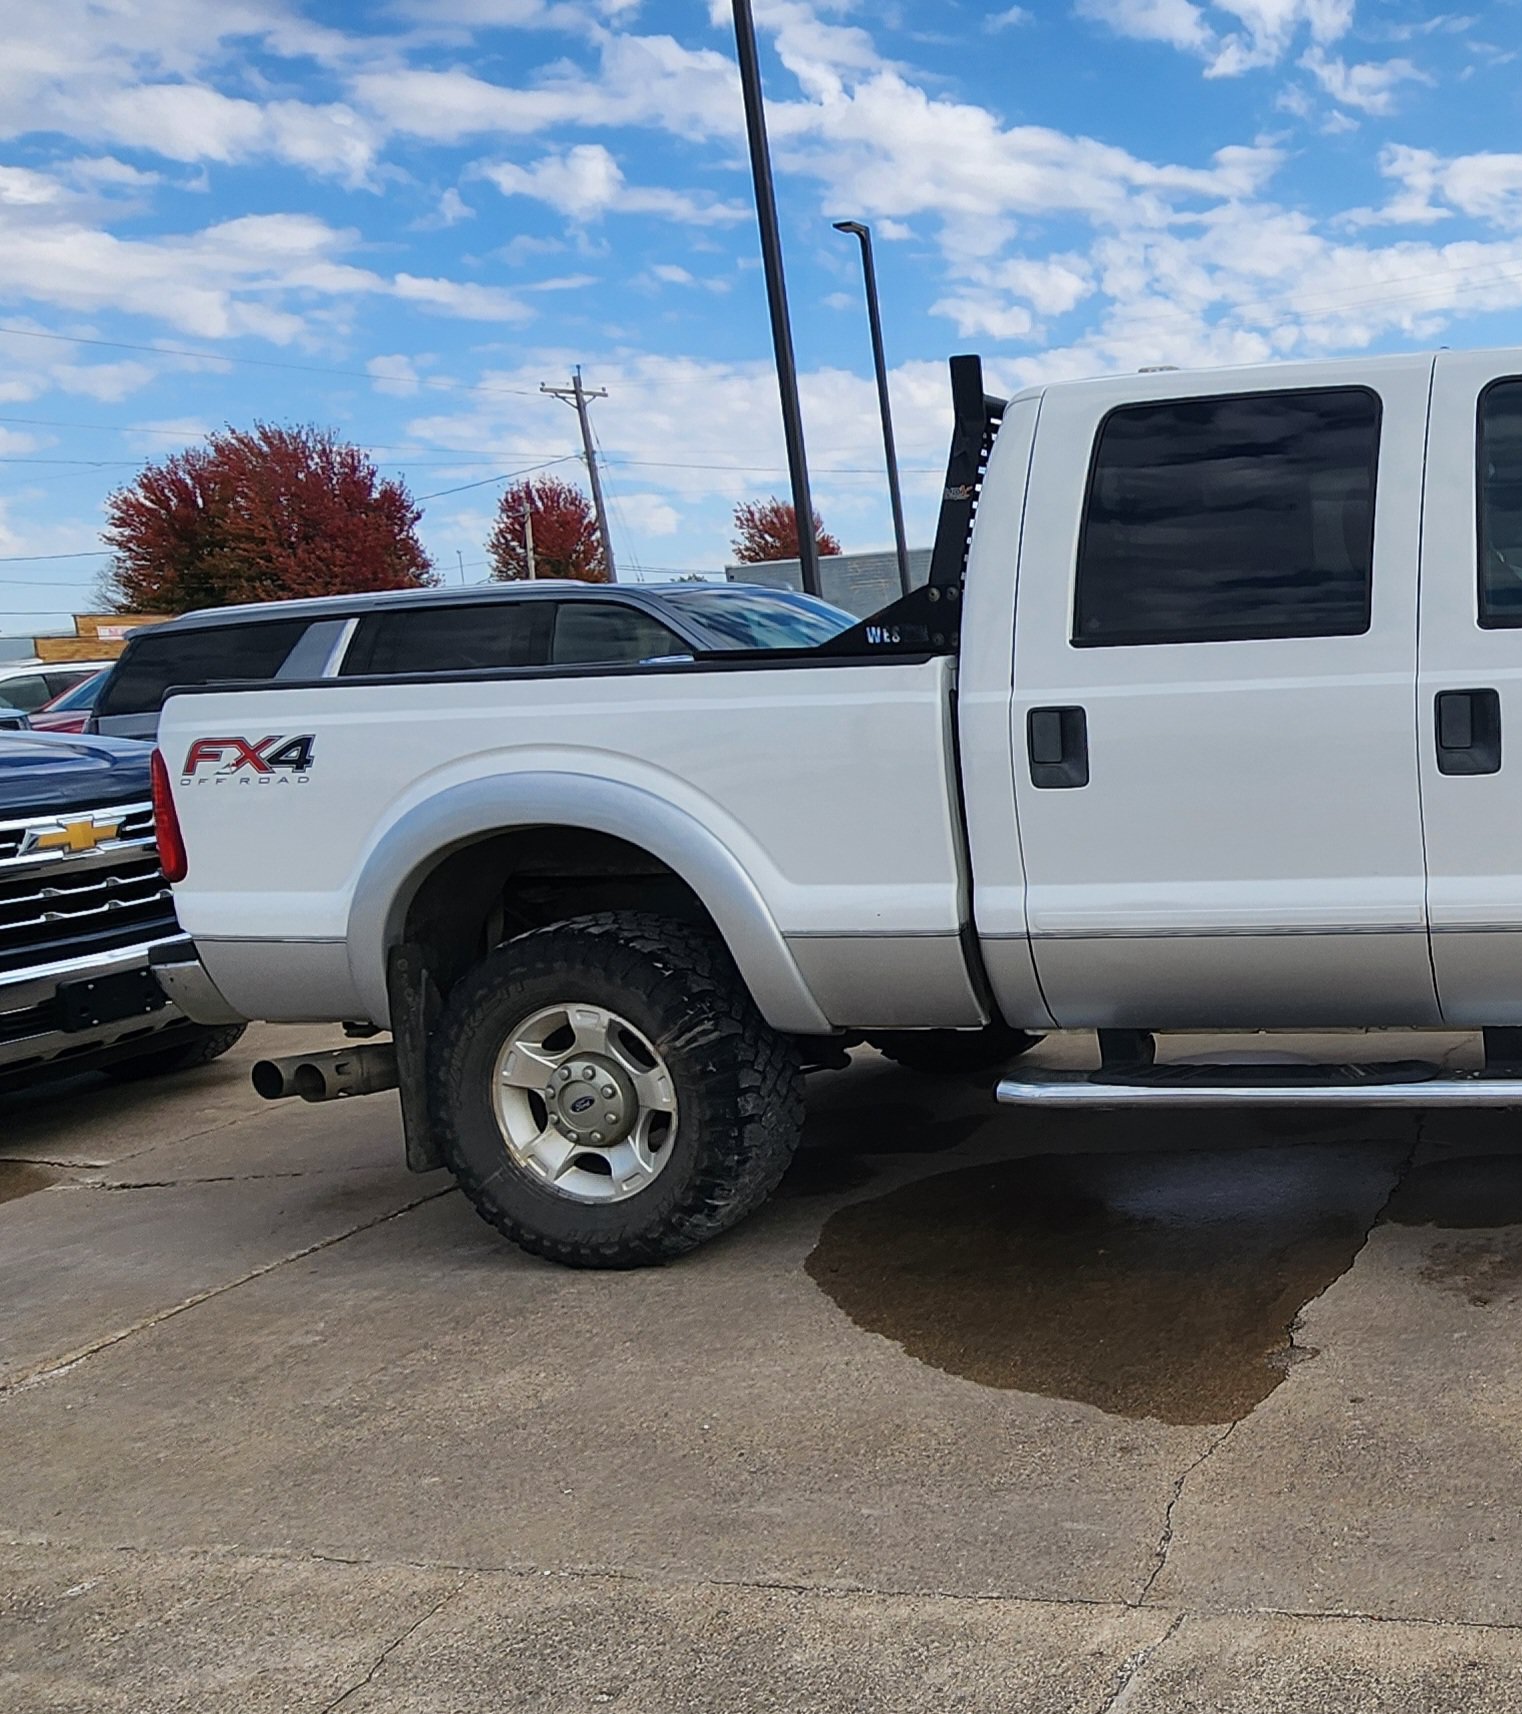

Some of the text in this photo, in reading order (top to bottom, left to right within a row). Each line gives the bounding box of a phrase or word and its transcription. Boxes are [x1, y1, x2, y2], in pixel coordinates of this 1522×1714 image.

[182, 734, 316, 776] FX4
[180, 776, 310, 786] OFF ROAD
